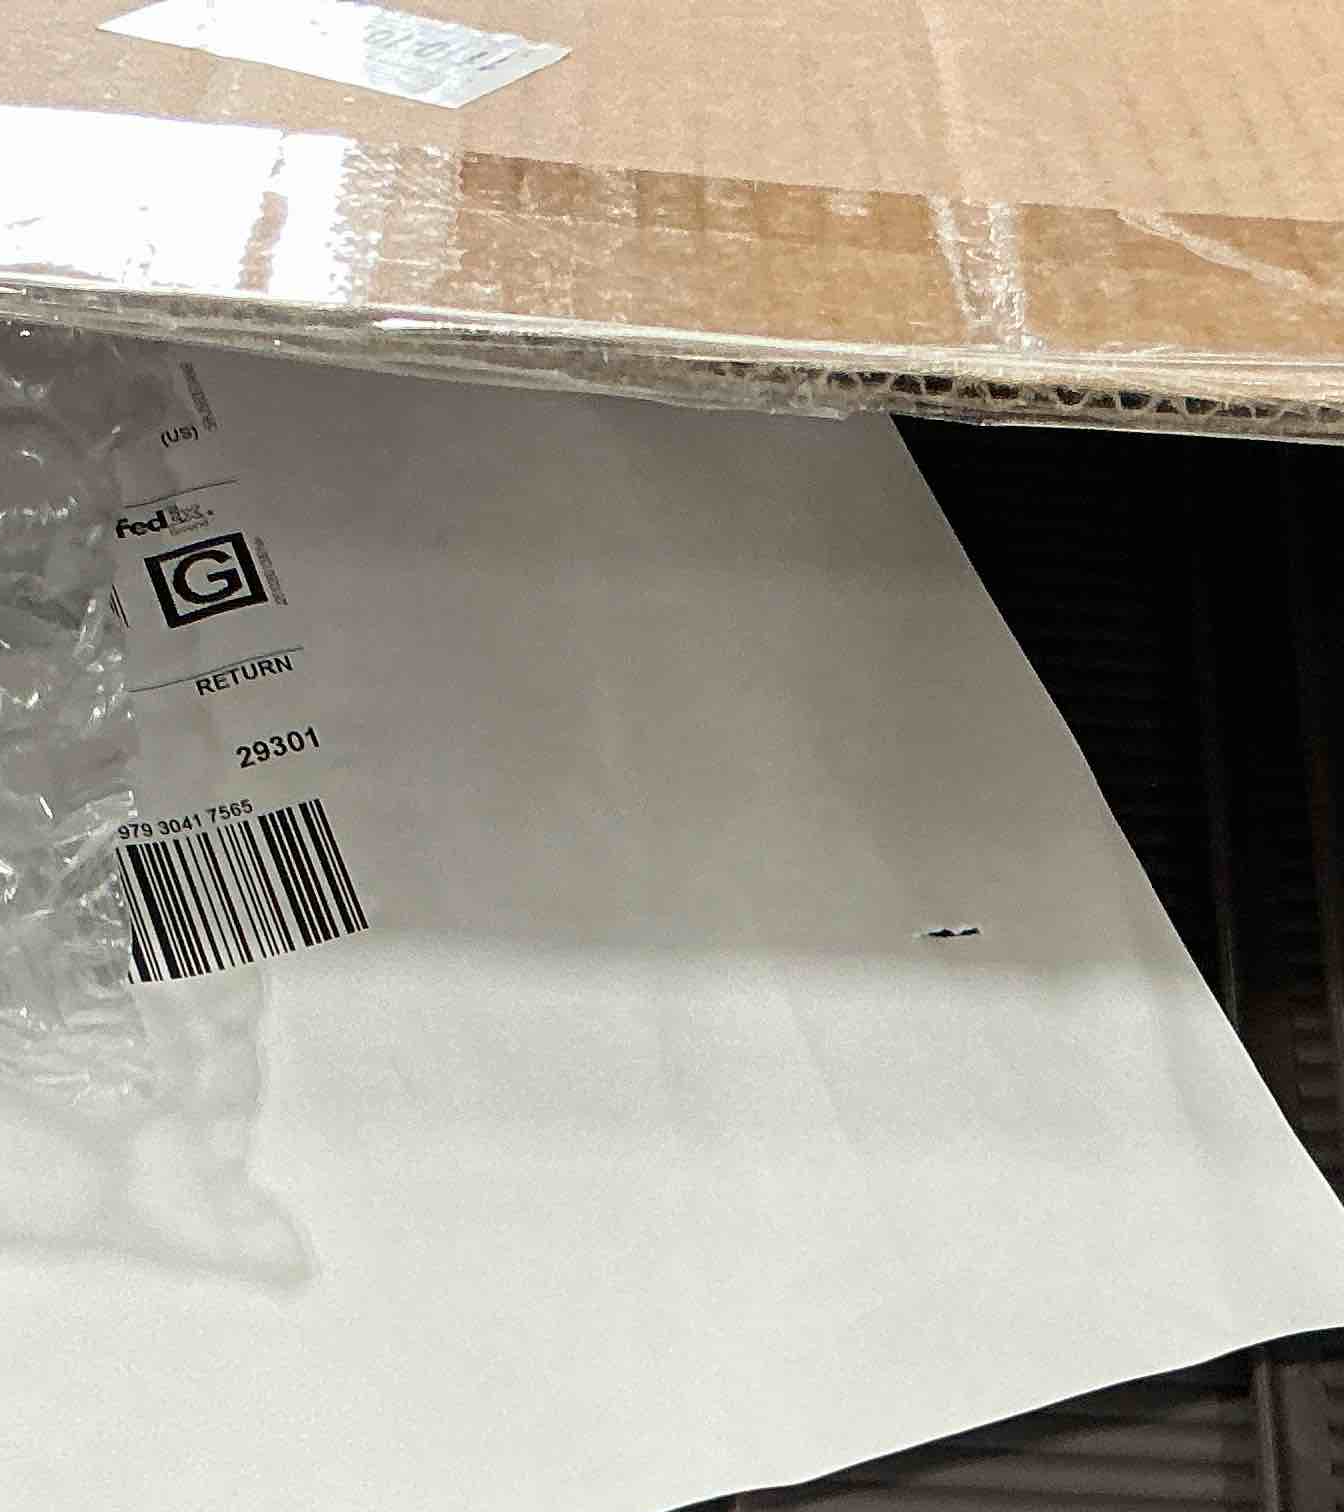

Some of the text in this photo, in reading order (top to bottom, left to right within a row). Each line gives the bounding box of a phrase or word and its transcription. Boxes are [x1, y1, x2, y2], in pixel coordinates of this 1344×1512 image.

[160, 425, 199, 448] (US)
[172, 549, 244, 605] G
[196, 655, 293, 696] RETURN
[235, 726, 320, 768] 29301
[158, 813, 202, 835] 3041
[205, 798, 253, 824] 7565
